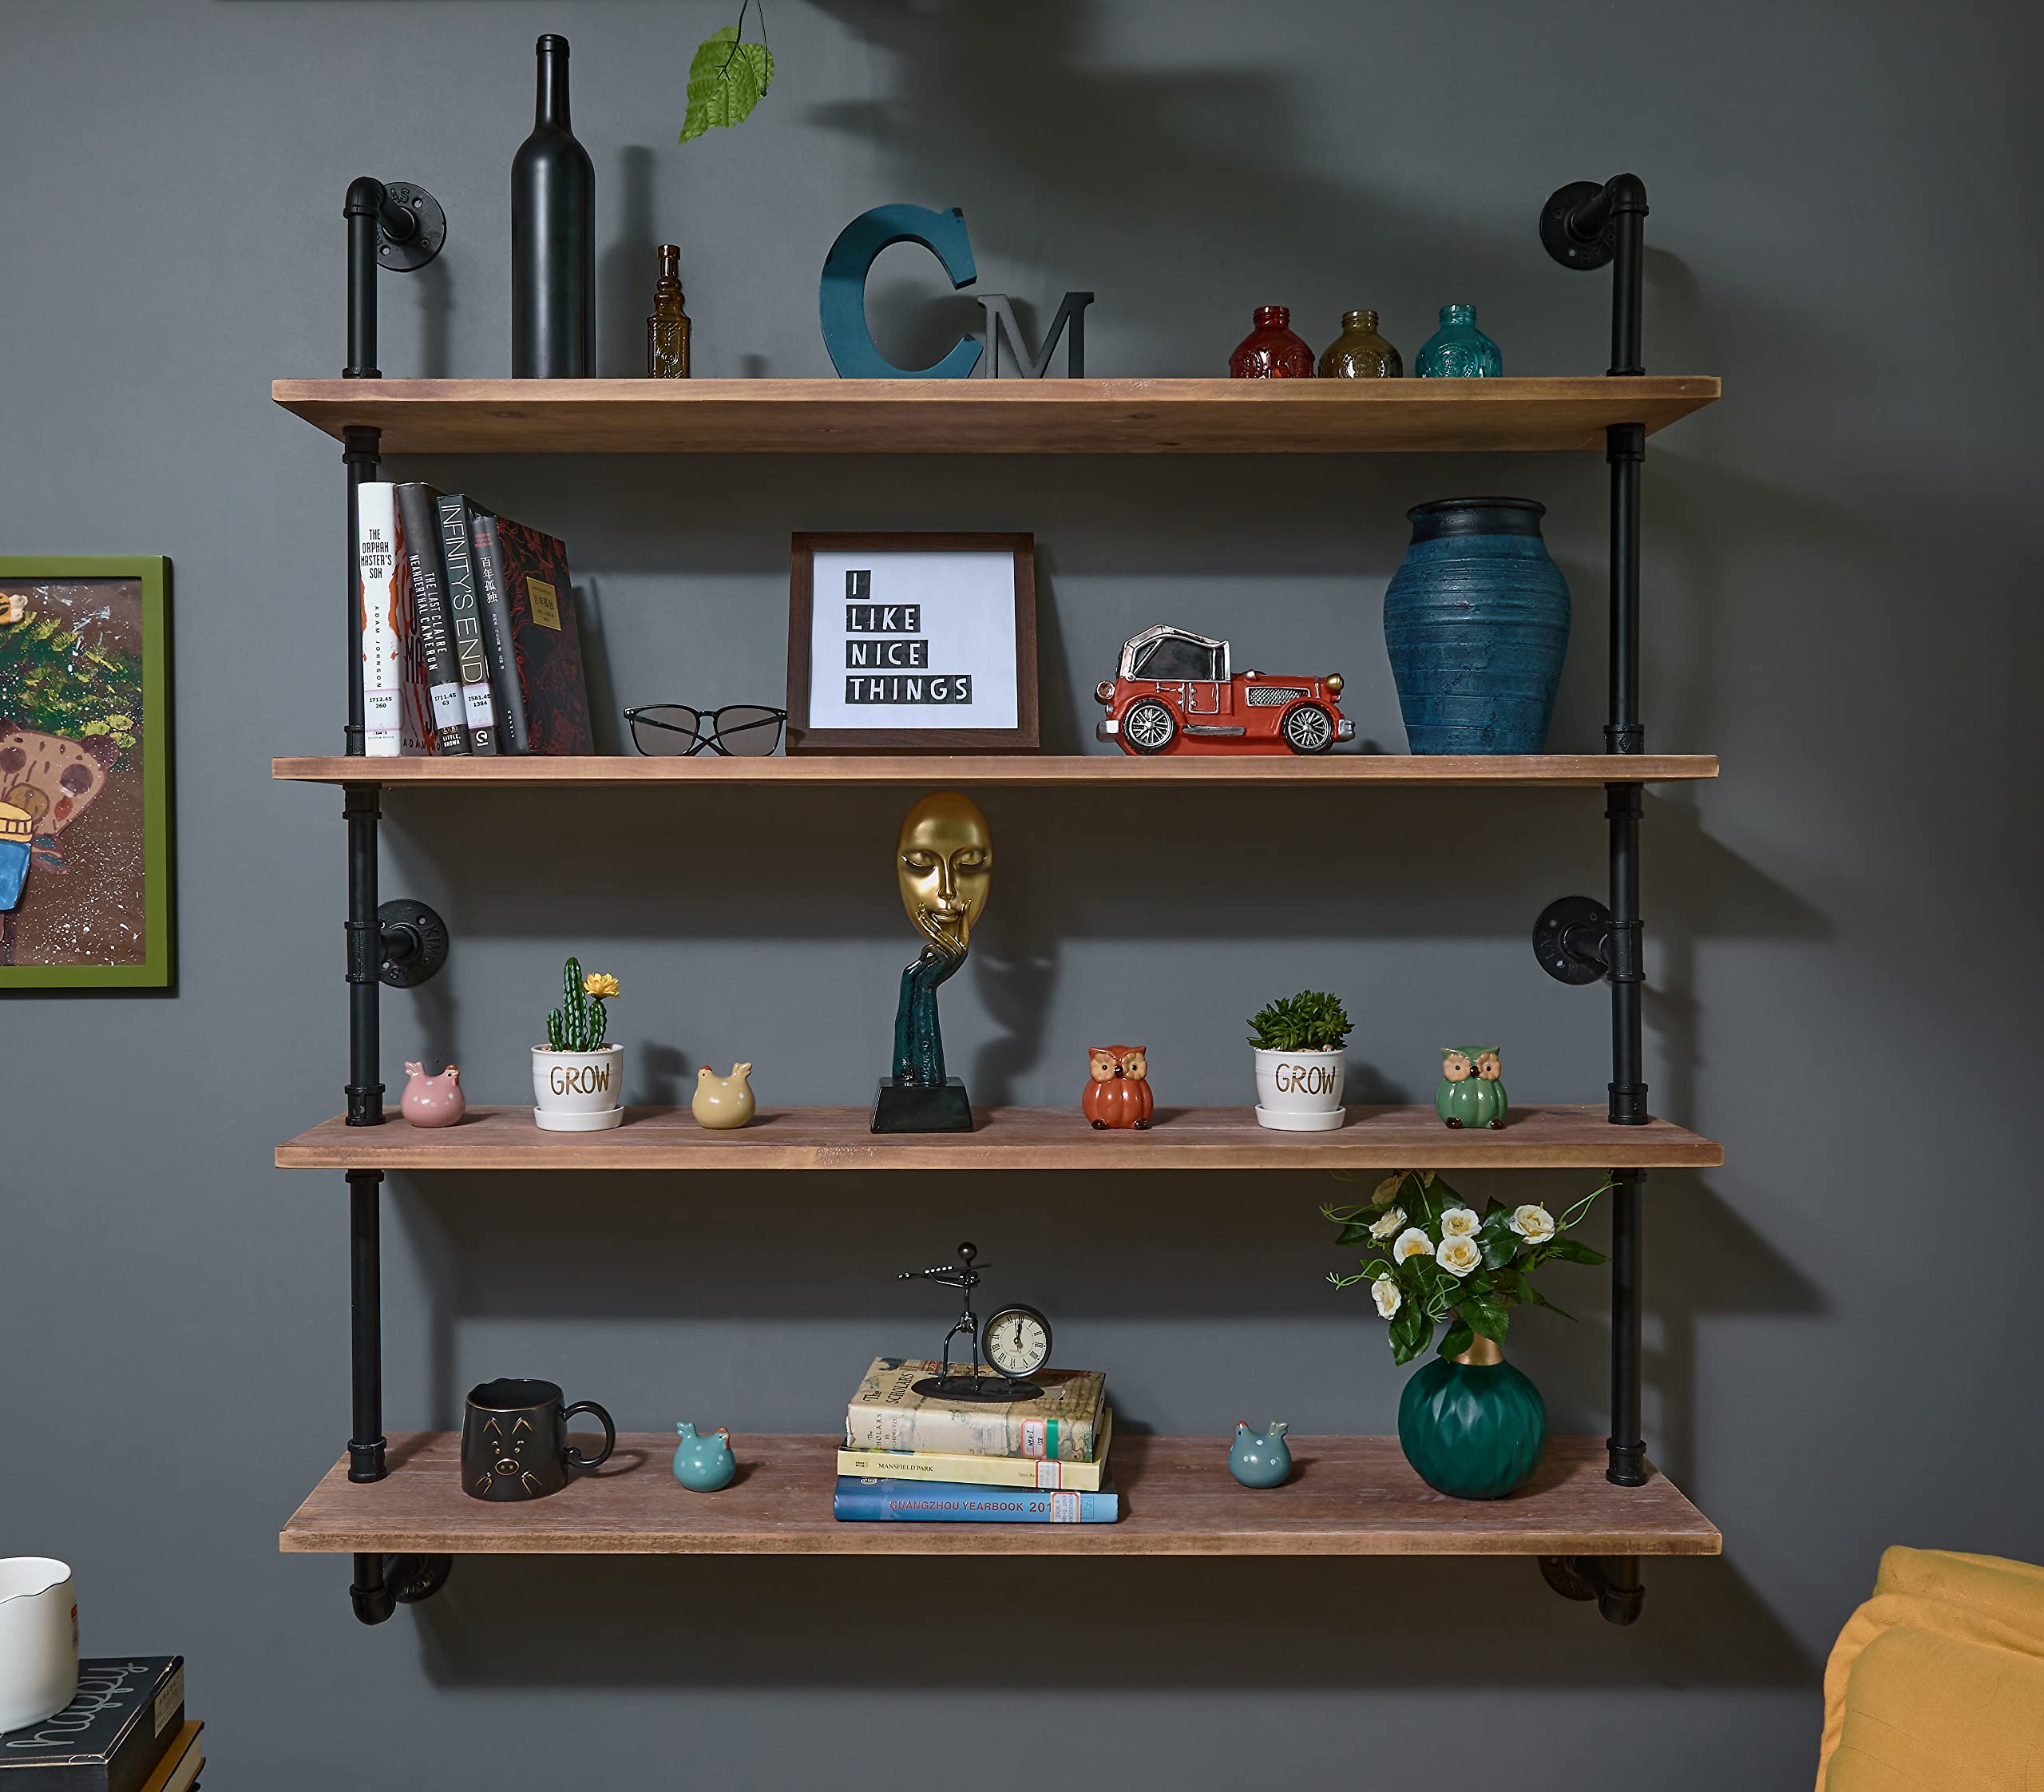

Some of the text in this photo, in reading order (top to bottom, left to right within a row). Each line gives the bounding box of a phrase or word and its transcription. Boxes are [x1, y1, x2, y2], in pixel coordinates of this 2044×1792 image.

[362, 541, 389, 553] ORPHAN
[369, 529, 380, 540] THE
[360, 554, 392, 566] MASTER'S
[369, 568, 382, 579] SON
[409, 554, 429, 615] NEANDERTHAL
[481, 556, 499, 604] 百年孤独
[852, 573, 858, 595] I
[425, 572, 441, 613] THE LAST
[441, 504, 483, 683] INFINITY'S END
[851, 607, 916, 630] LIKE
[420, 617, 438, 671] CAMERON
[431, 614, 447, 653] CLAIRE
[851, 643, 921, 665] NICE
[849, 677, 968, 700] THINGS
[550, 1062, 610, 1096] GROW
[1275, 1063, 1336, 1095] GROW
[863, 1390, 882, 1402] The
[885, 1374, 914, 1404] SCHOLARS
[889, 1501, 959, 1511] GUANGZHOU
[962, 1502, 1024, 1511] YEARBOOK
[6, 1662, 149, 1748] happy
